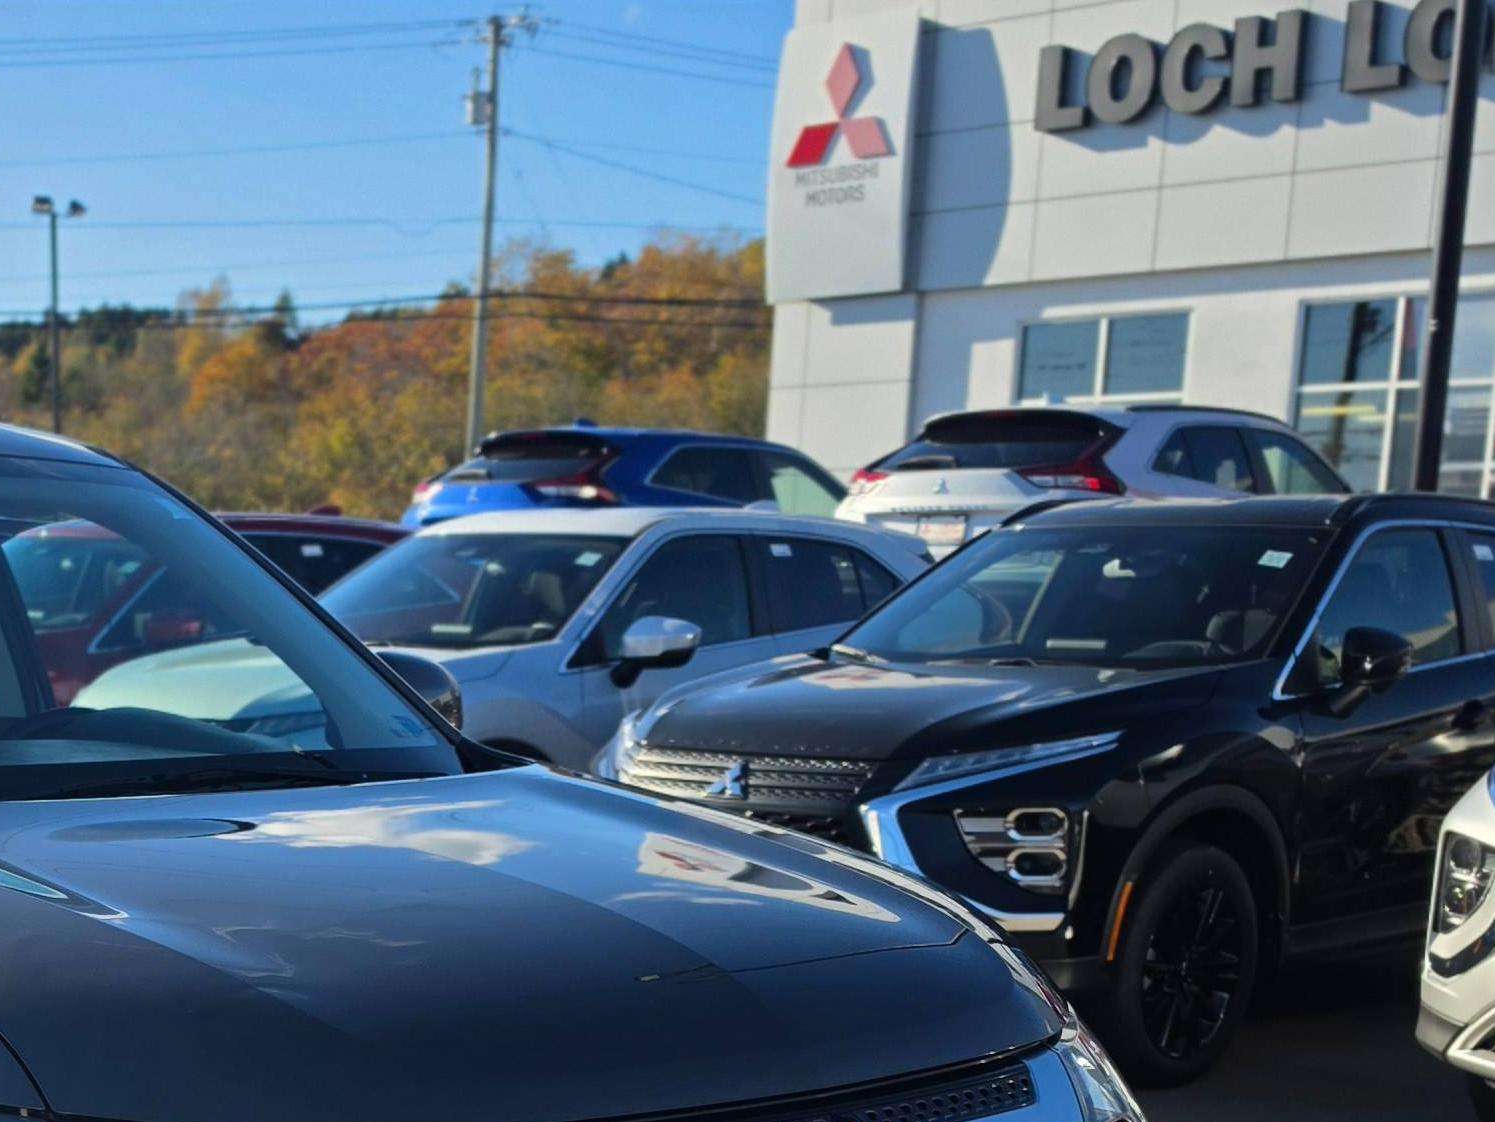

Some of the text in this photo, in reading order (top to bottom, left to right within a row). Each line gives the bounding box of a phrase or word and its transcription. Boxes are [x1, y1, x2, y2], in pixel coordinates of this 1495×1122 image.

[1033, 0, 1476, 132] LOCH LO
[791, 161, 880, 189] MITSUBISHI
[805, 184, 865, 208] MOTORS
